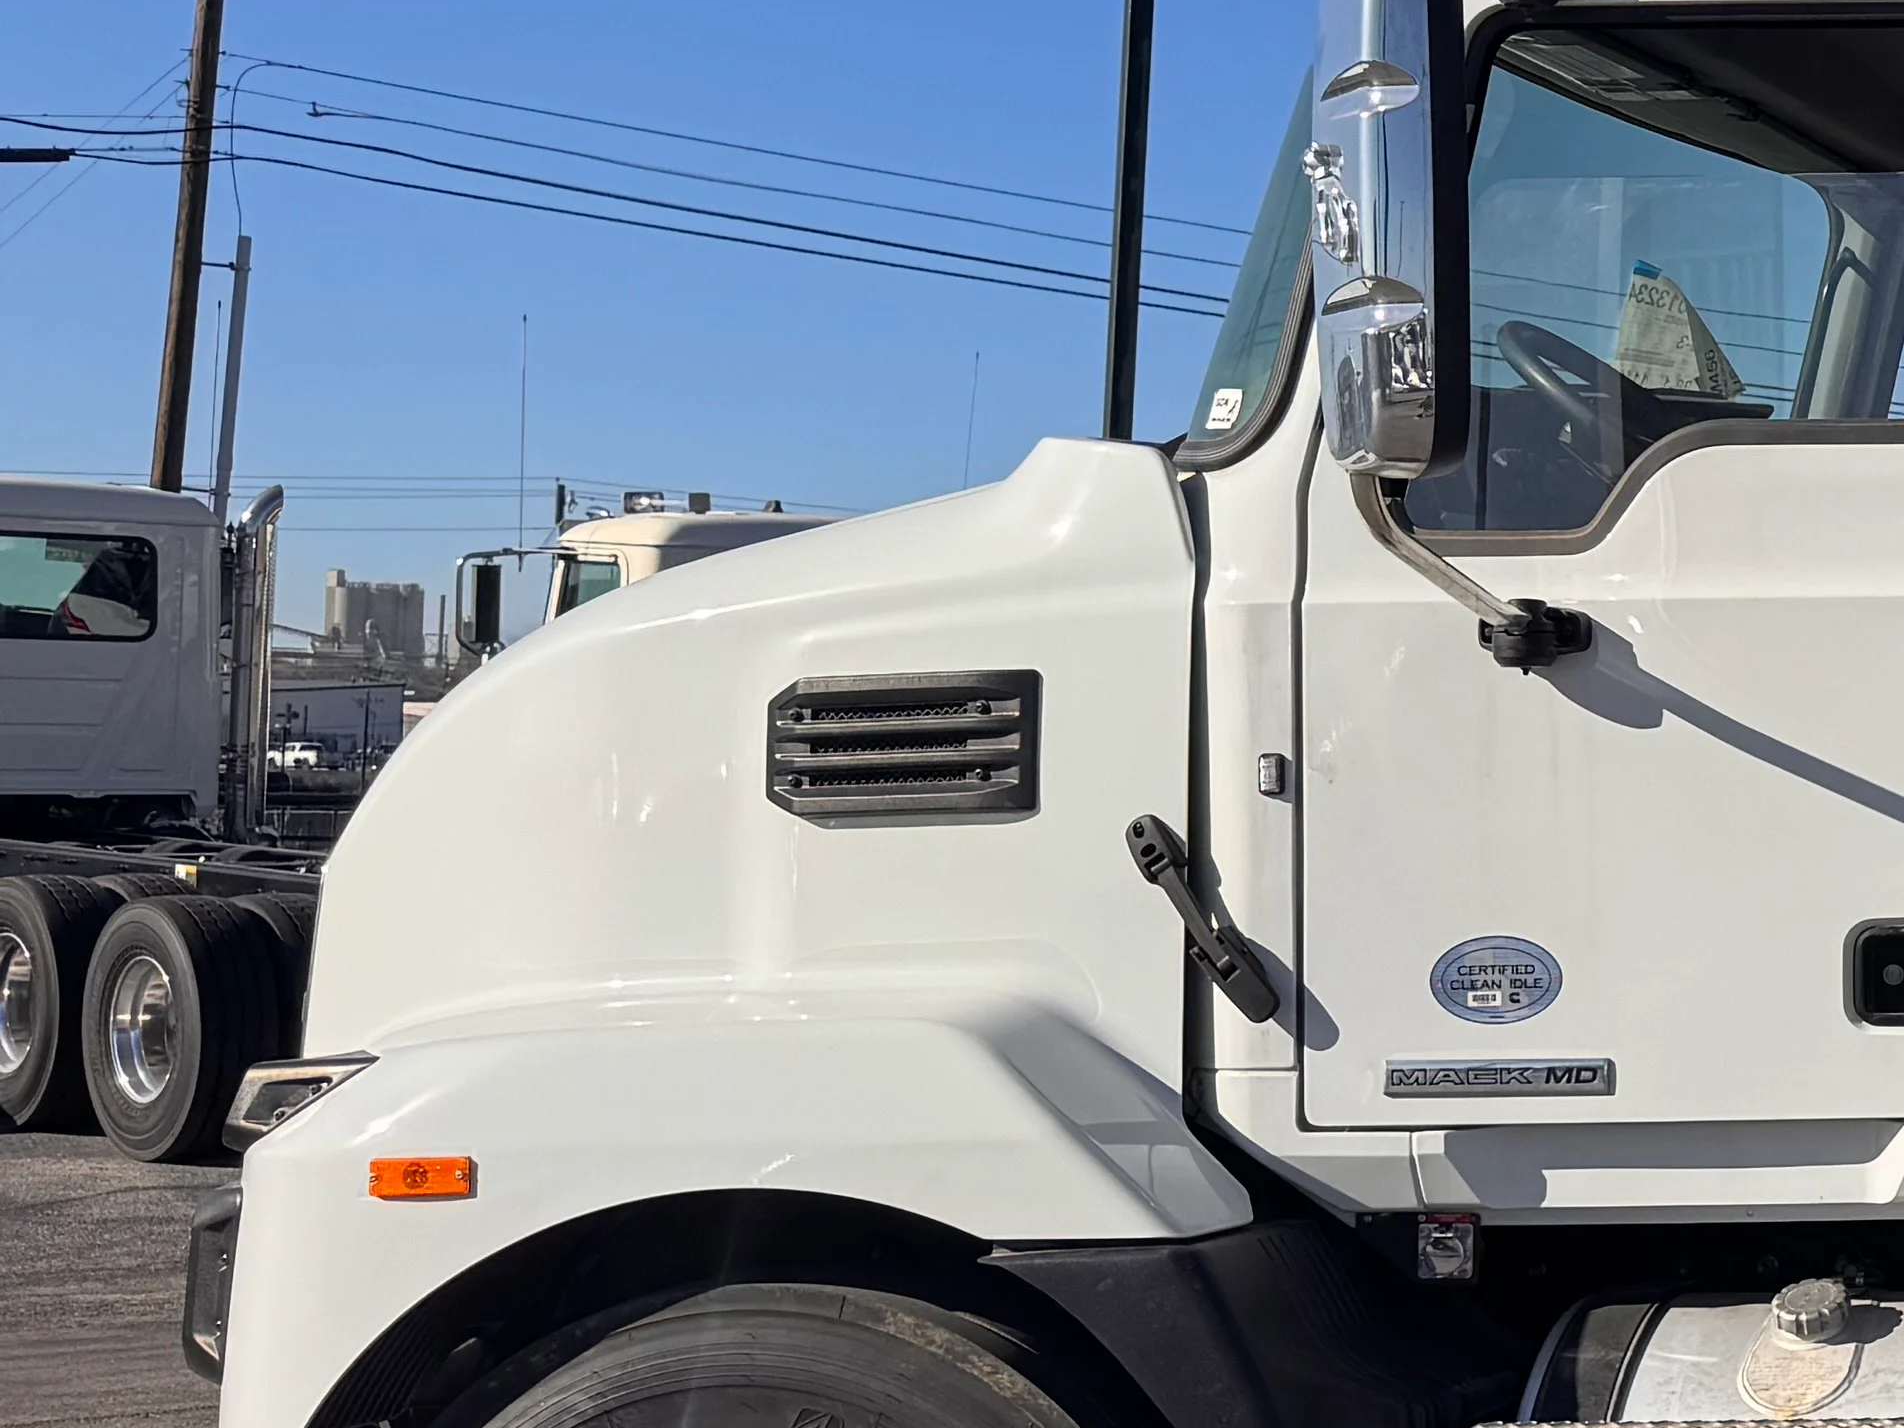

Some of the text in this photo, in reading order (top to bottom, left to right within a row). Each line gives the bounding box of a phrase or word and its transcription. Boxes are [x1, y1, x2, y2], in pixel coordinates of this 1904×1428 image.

[1456, 964, 1536, 977] CERTIFIED
[1449, 977, 1544, 991] CLEAN IDLE
[1390, 1067, 1598, 1086] MACK MD
